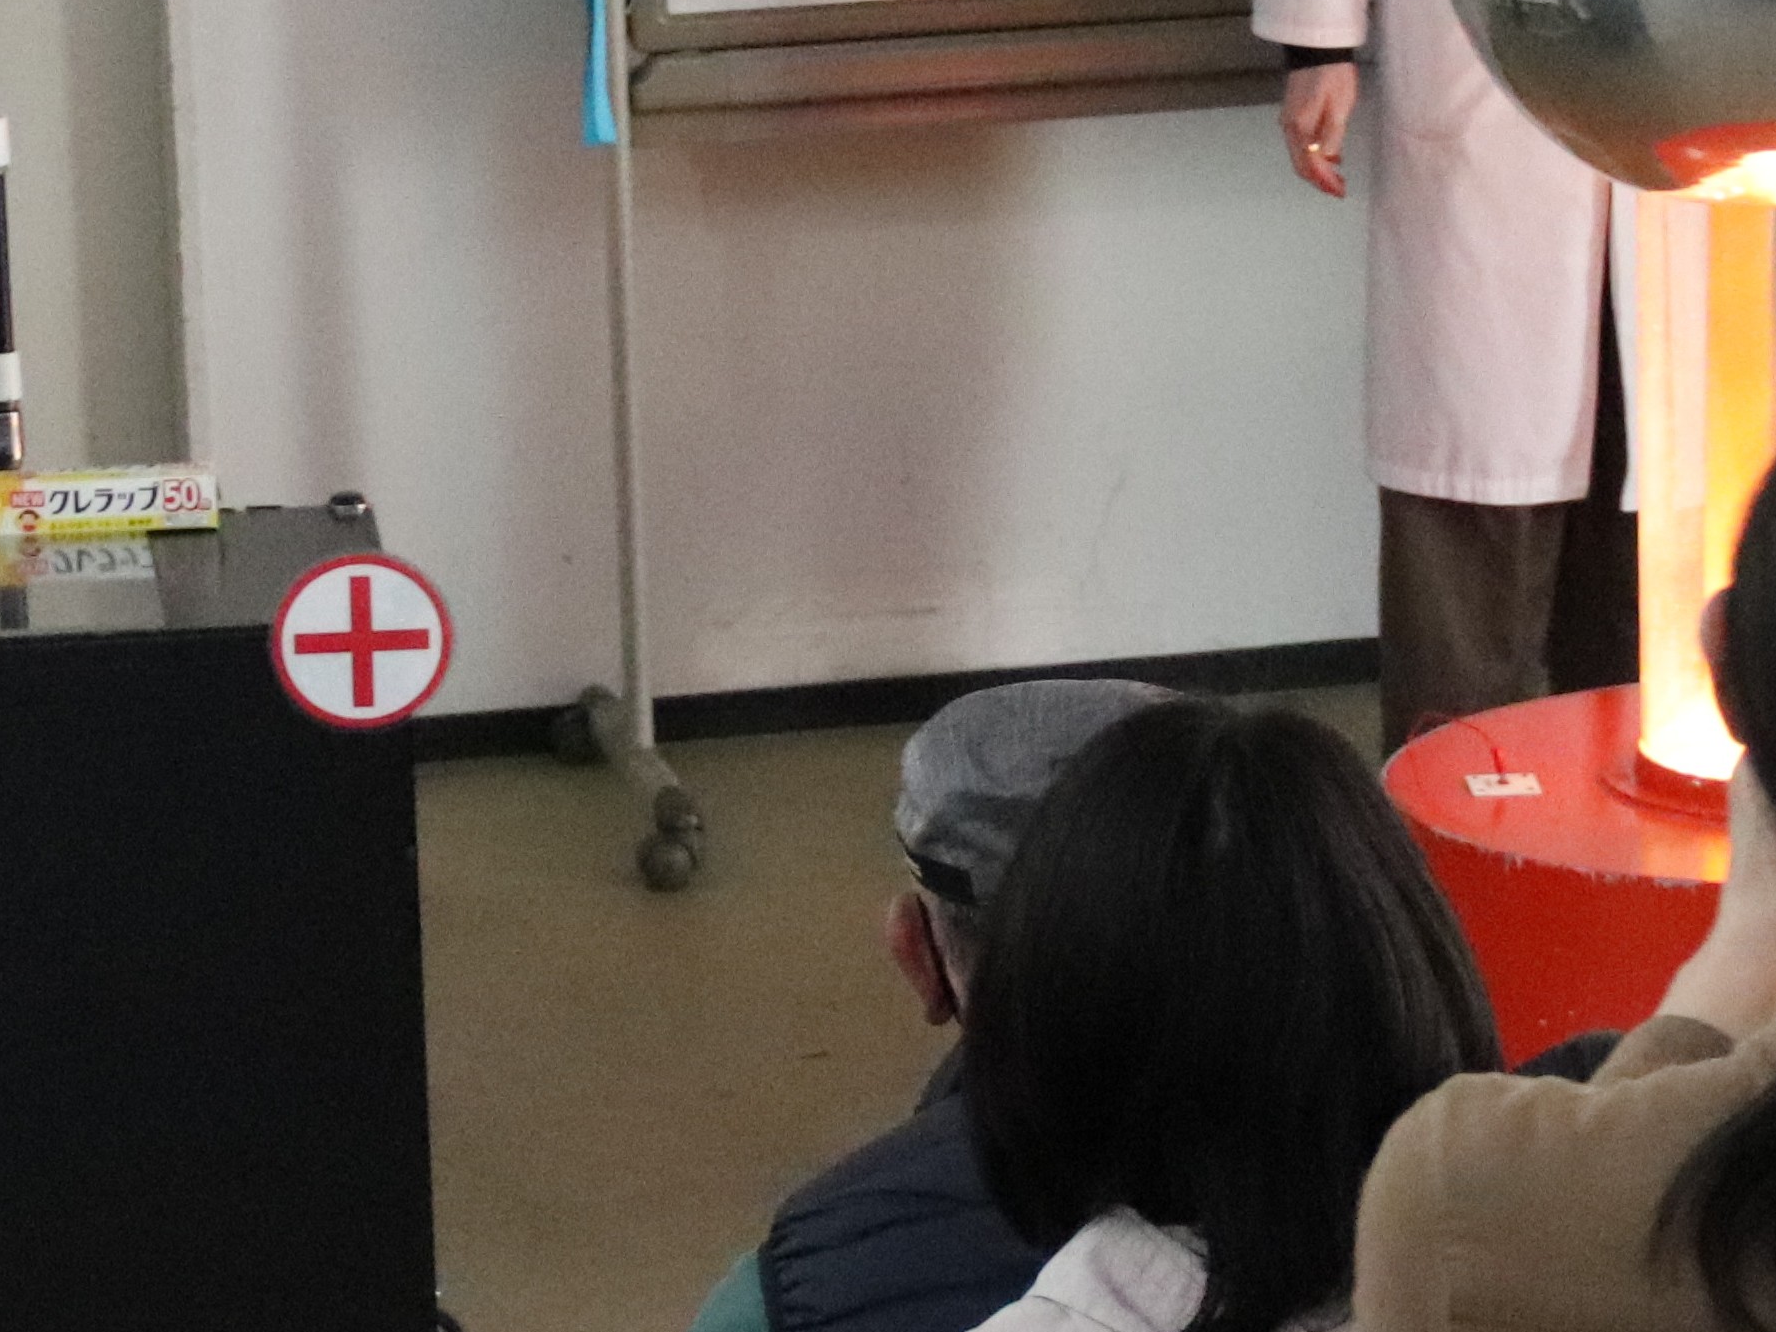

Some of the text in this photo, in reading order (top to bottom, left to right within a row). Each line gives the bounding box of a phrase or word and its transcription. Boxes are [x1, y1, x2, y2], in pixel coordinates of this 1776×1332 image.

[49, 480, 160, 514] クレラップ
